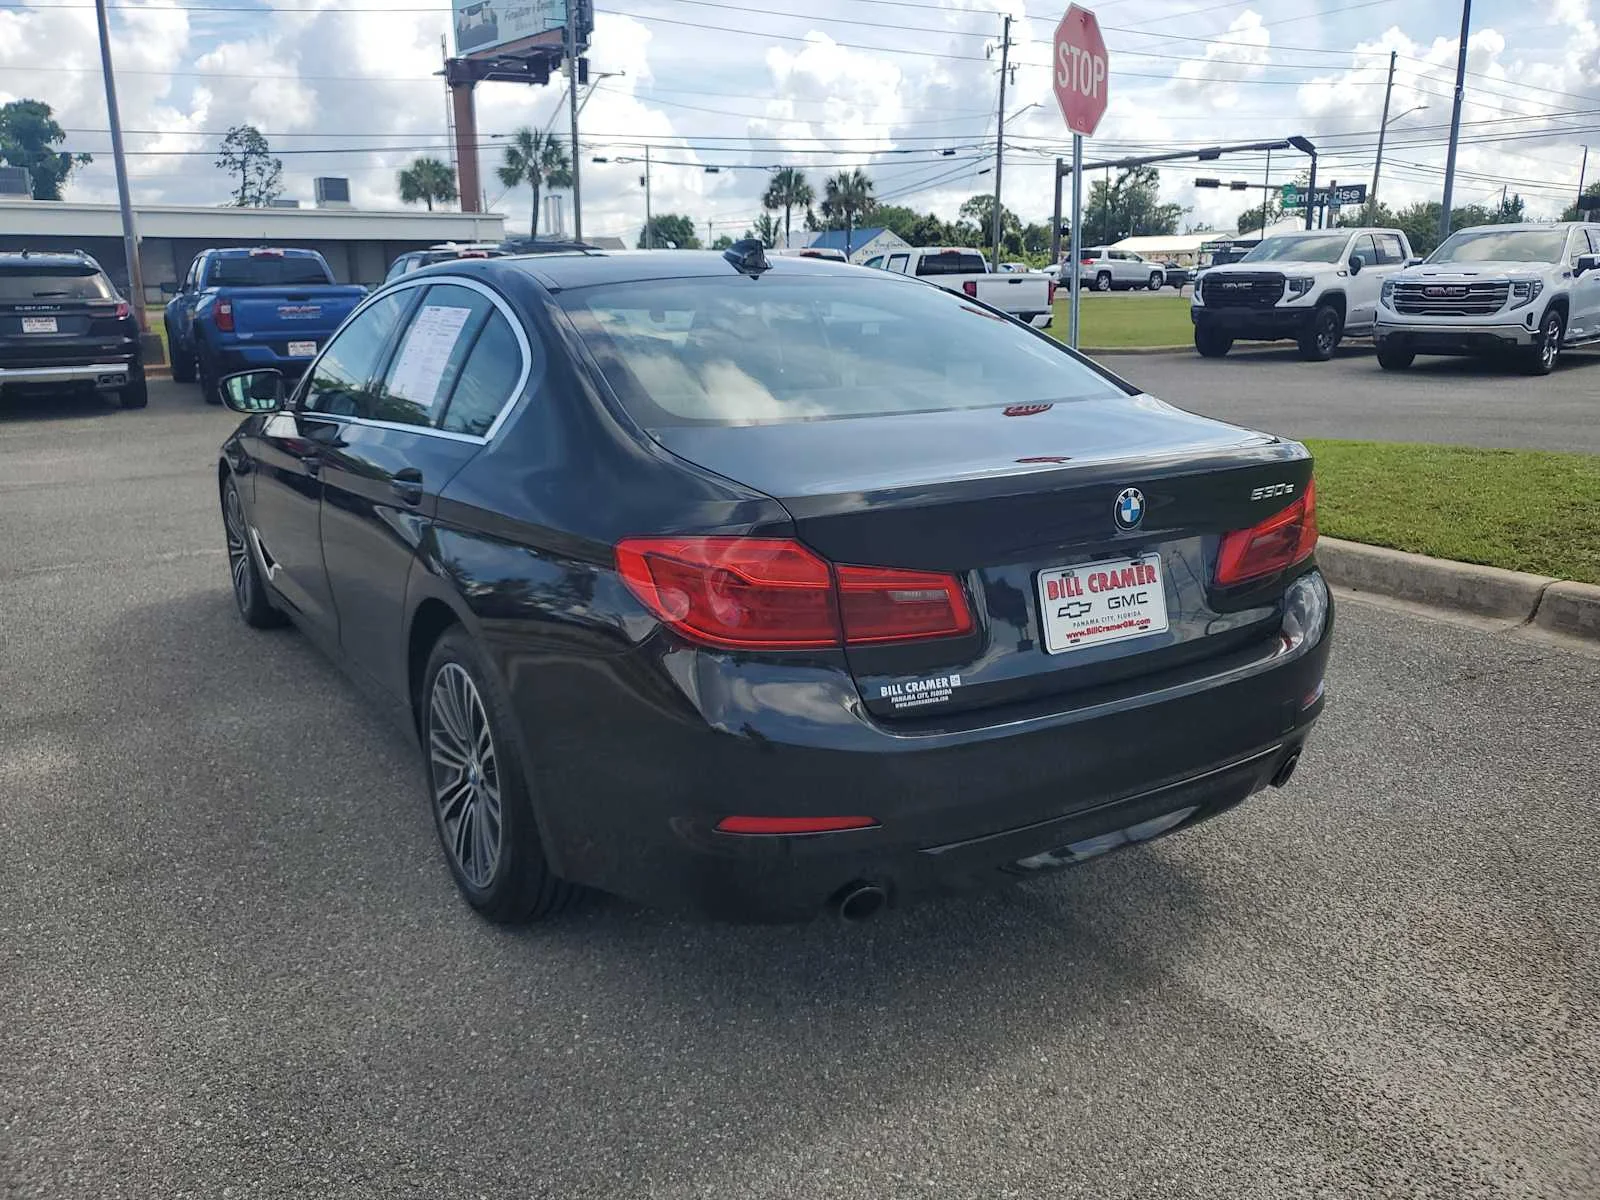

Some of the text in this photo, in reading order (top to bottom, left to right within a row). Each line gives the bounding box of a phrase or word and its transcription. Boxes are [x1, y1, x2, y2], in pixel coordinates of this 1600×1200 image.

[1058, 41, 1105, 99] STOP
[1425, 286, 1467, 297] GMC
[1047, 565, 1158, 601] BILL CRAMER
[1108, 591, 1149, 610] GMC
[1066, 617, 1151, 640] www.BillCramerGM.com
[1073, 617, 1100, 629] PANAMA
[1117, 610, 1142, 621] FLORIDA
[880, 684, 903, 697] BILL
[905, 677, 950, 693] CRAMER
[891, 694, 916, 704] PANAMA
